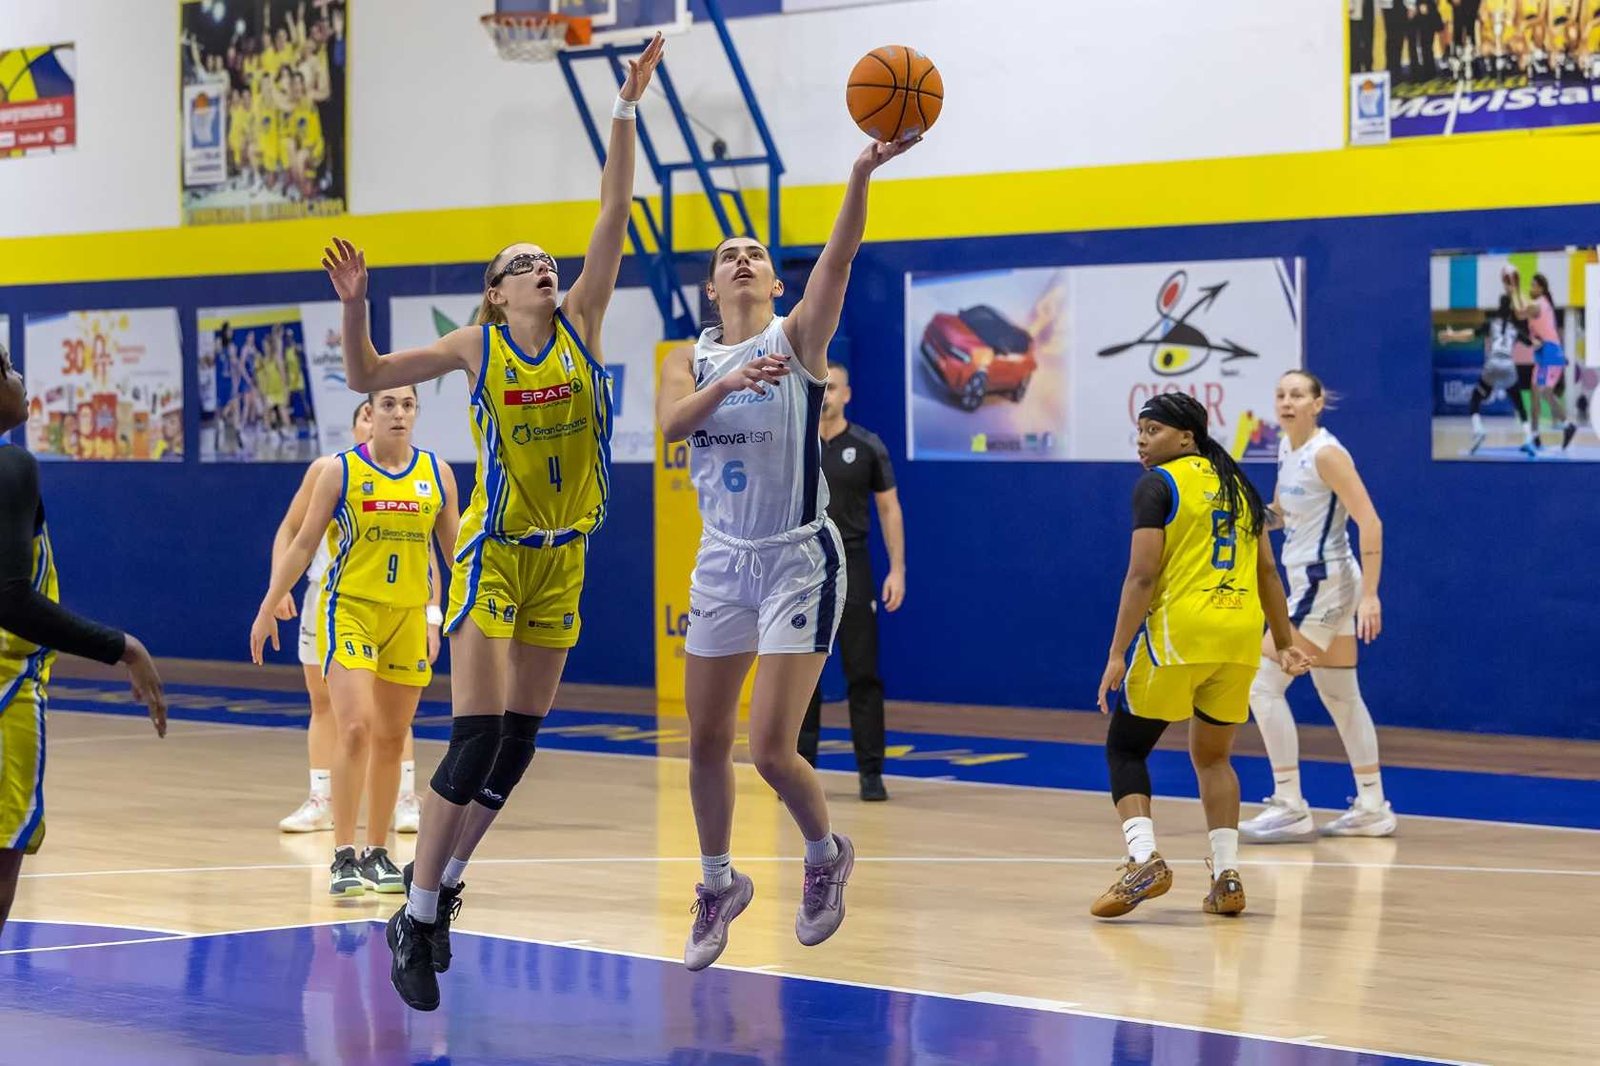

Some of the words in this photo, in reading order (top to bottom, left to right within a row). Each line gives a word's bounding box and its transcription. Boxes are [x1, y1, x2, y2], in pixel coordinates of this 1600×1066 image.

[521, 385, 571, 403] SPAR
[548, 456, 562, 492] 4
[722, 460, 748, 493] 6
[375, 501, 419, 510] SPAR
[1211, 509, 1237, 571] 8
[386, 553, 399, 583] 9
[487, 598, 498, 621] 4
[344, 640, 356, 656] 9
